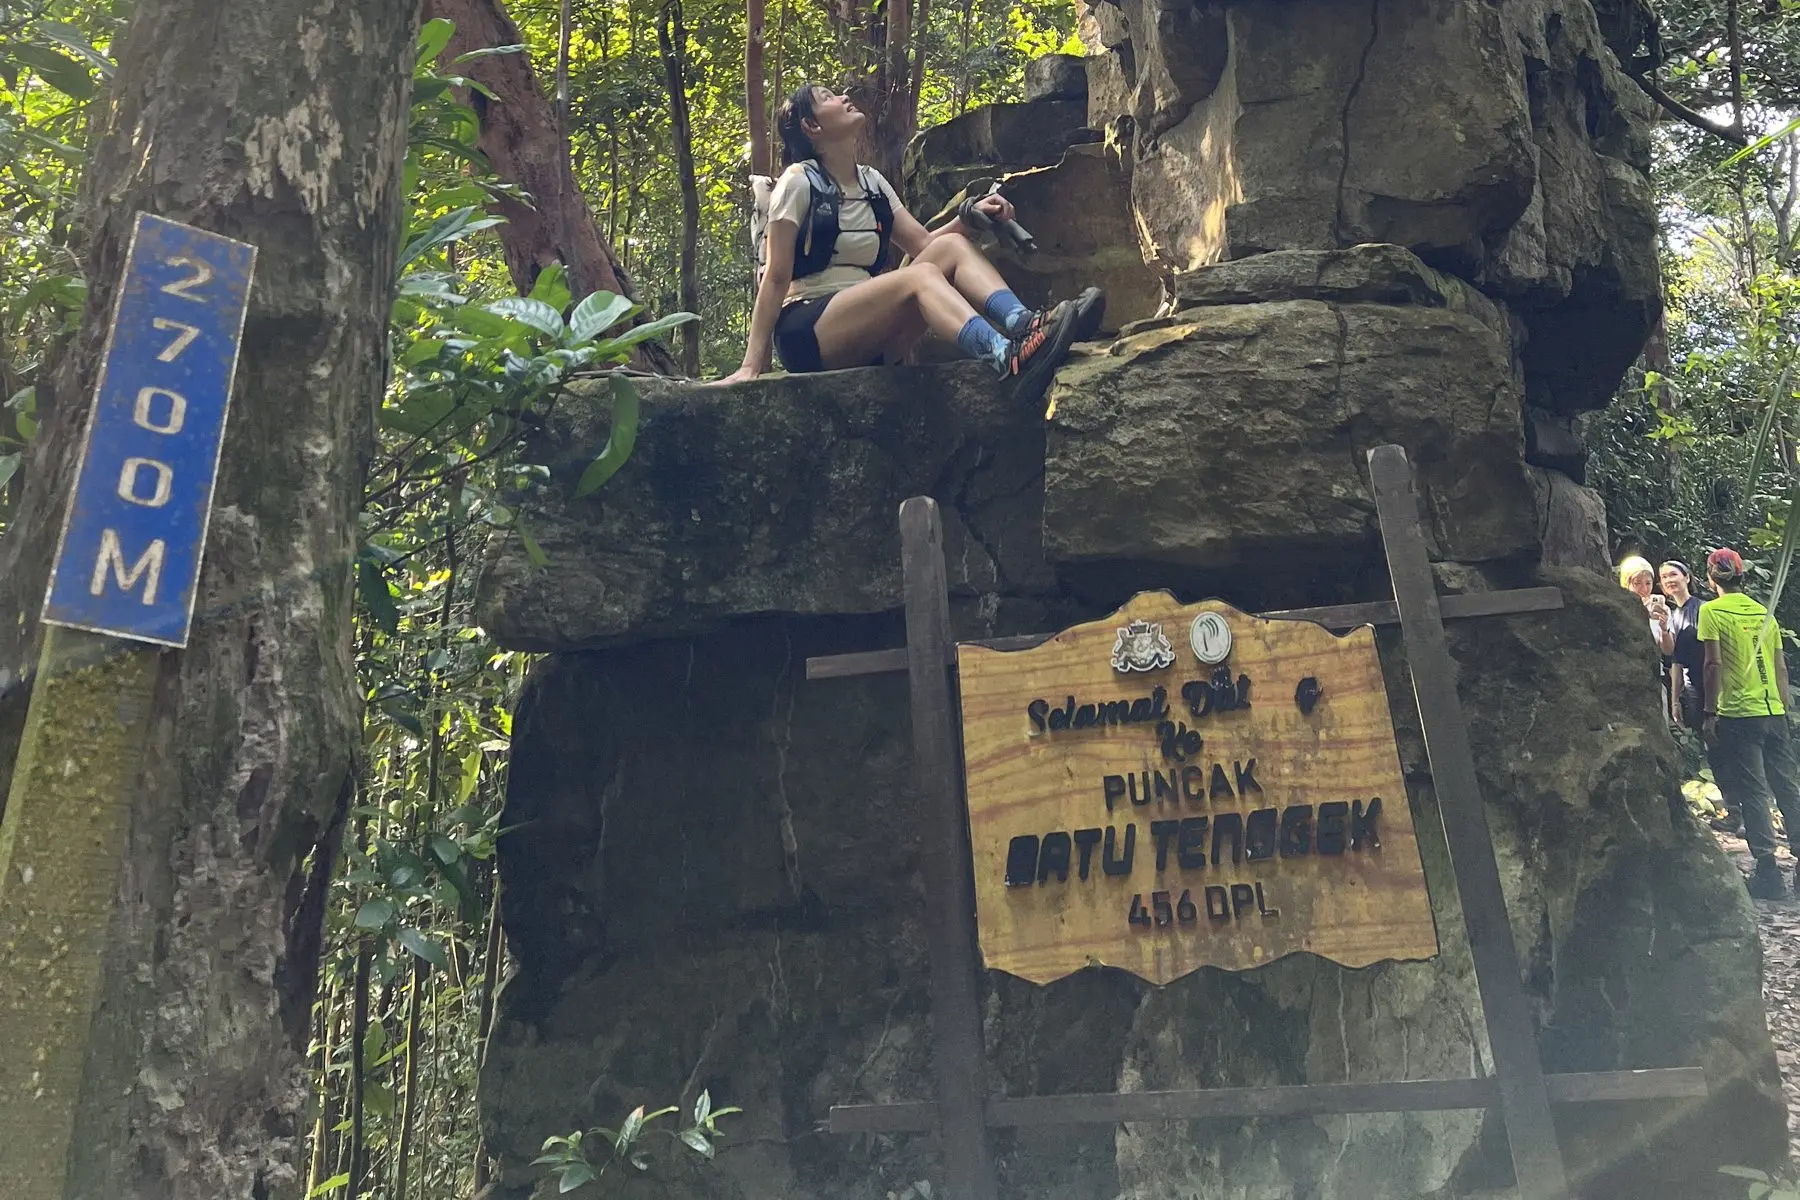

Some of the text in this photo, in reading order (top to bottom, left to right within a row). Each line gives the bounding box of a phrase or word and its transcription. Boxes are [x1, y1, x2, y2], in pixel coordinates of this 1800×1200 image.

[90, 255, 215, 606] 2700M
[1028, 686, 1170, 732] Selamat
[1156, 720, 1203, 762] Ke
[1104, 759, 1263, 811] PUNCAK
[1128, 881, 1280, 927] 456 DPL
